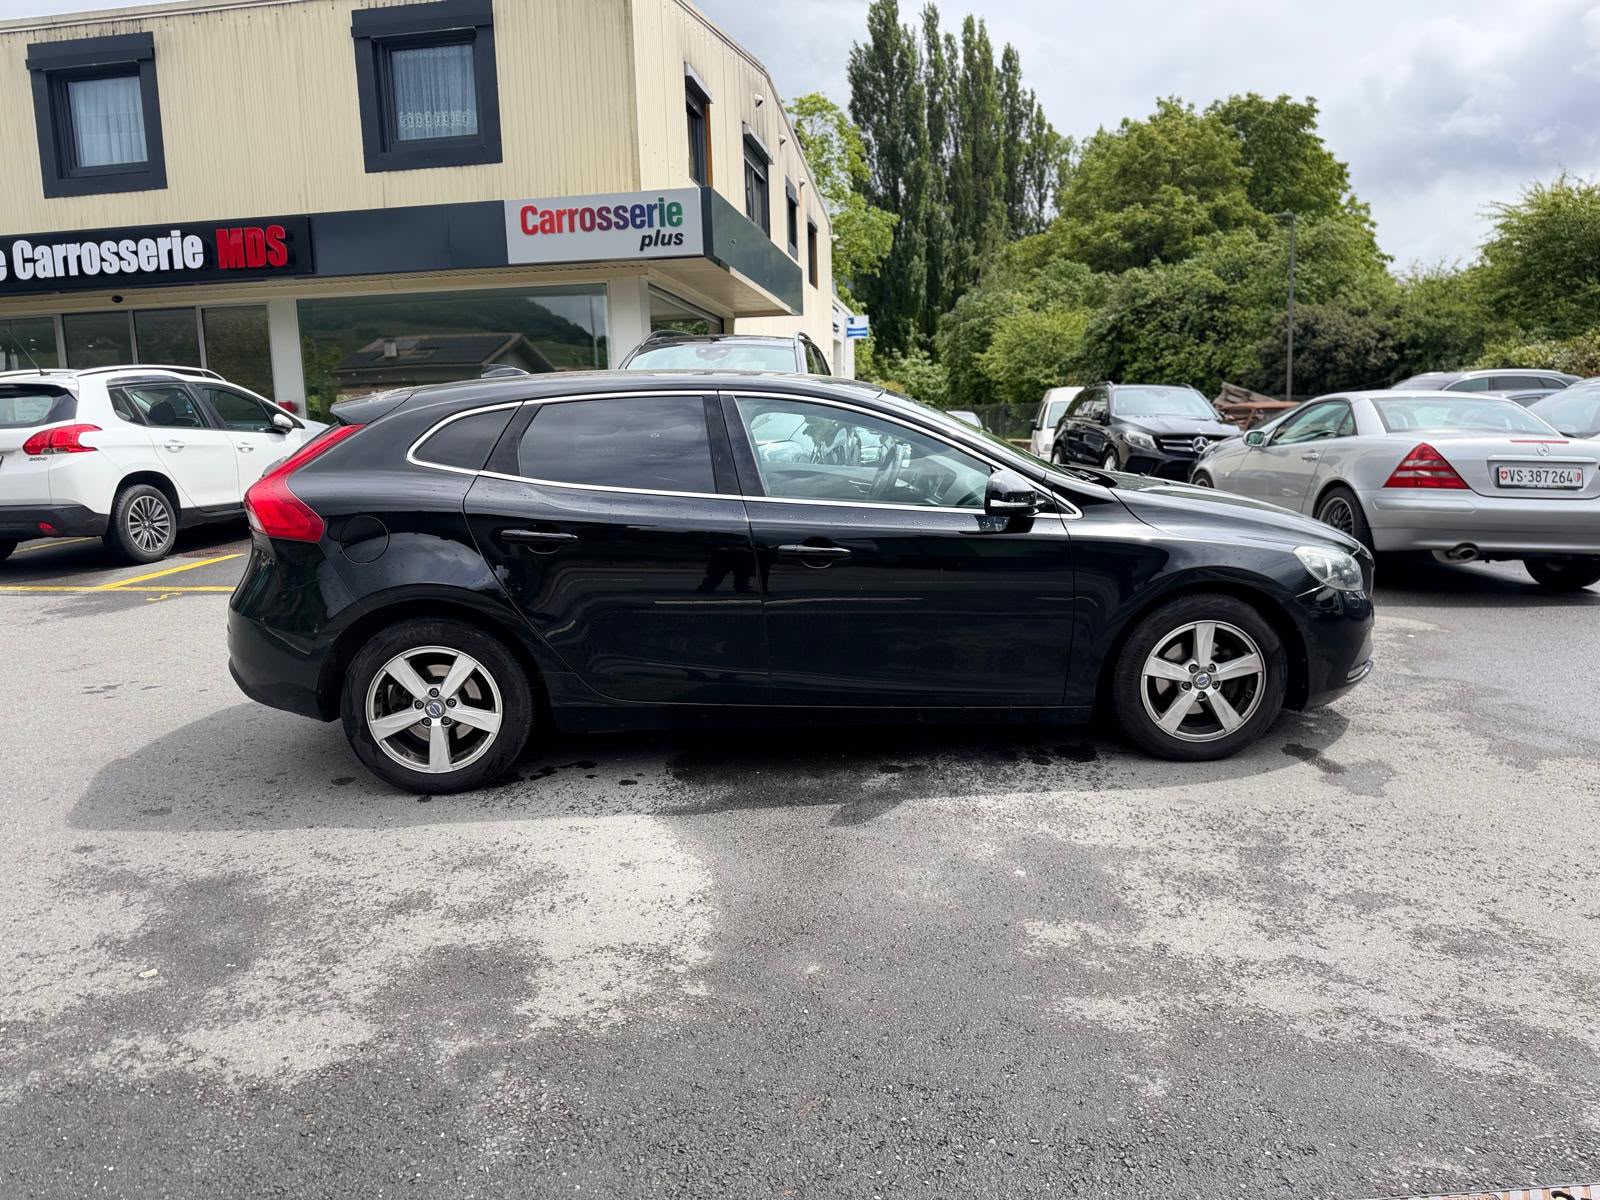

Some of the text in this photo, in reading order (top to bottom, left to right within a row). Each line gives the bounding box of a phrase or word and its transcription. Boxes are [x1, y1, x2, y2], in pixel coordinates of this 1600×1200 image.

[520, 197, 684, 236] Carrosserie
[12, 230, 205, 280] Carrosserie
[215, 224, 289, 269] MDS
[640, 229, 684, 252] plus
